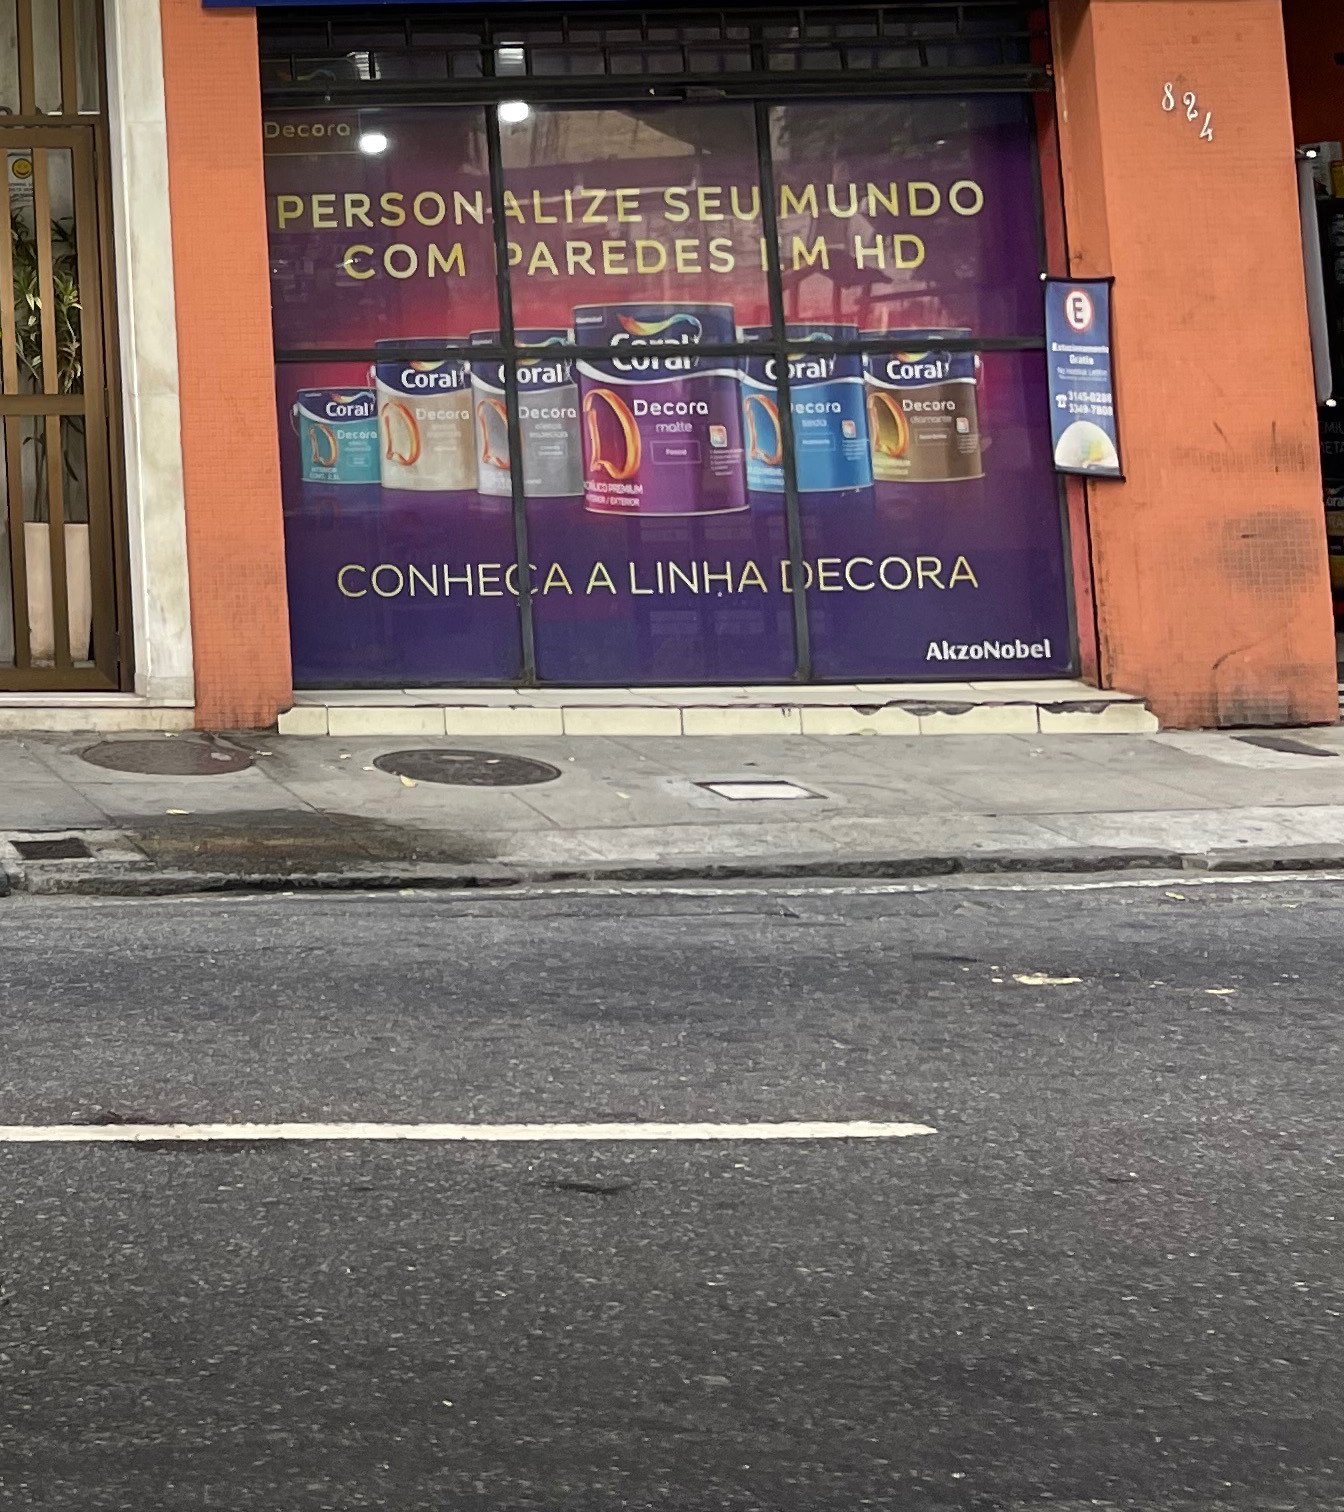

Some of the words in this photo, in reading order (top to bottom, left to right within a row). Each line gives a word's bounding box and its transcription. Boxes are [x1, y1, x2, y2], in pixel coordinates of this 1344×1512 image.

[264, 121, 351, 138] Decora
[277, 187, 643, 229] PERSONALIZE
[663, 186, 761, 222] SEU
[780, 180, 984, 219] MUNDO
[343, 242, 466, 280] COM
[507, 238, 735, 276] PAREDES
[854, 234, 926, 270] HD
[887, 360, 943, 379] Coral
[401, 369, 457, 388] Coral
[326, 402, 369, 417] Coral
[519, 406, 577, 419] Decora
[634, 399, 709, 416] Decora
[790, 402, 842, 413] ecora
[903, 400, 956, 411] Decora
[416, 408, 470, 421] Decora
[586, 561, 617, 595] A
[629, 560, 768, 594] LINHA
[781, 556, 978, 593] DECORA
[926, 638, 1051, 660] AkzoNobel
